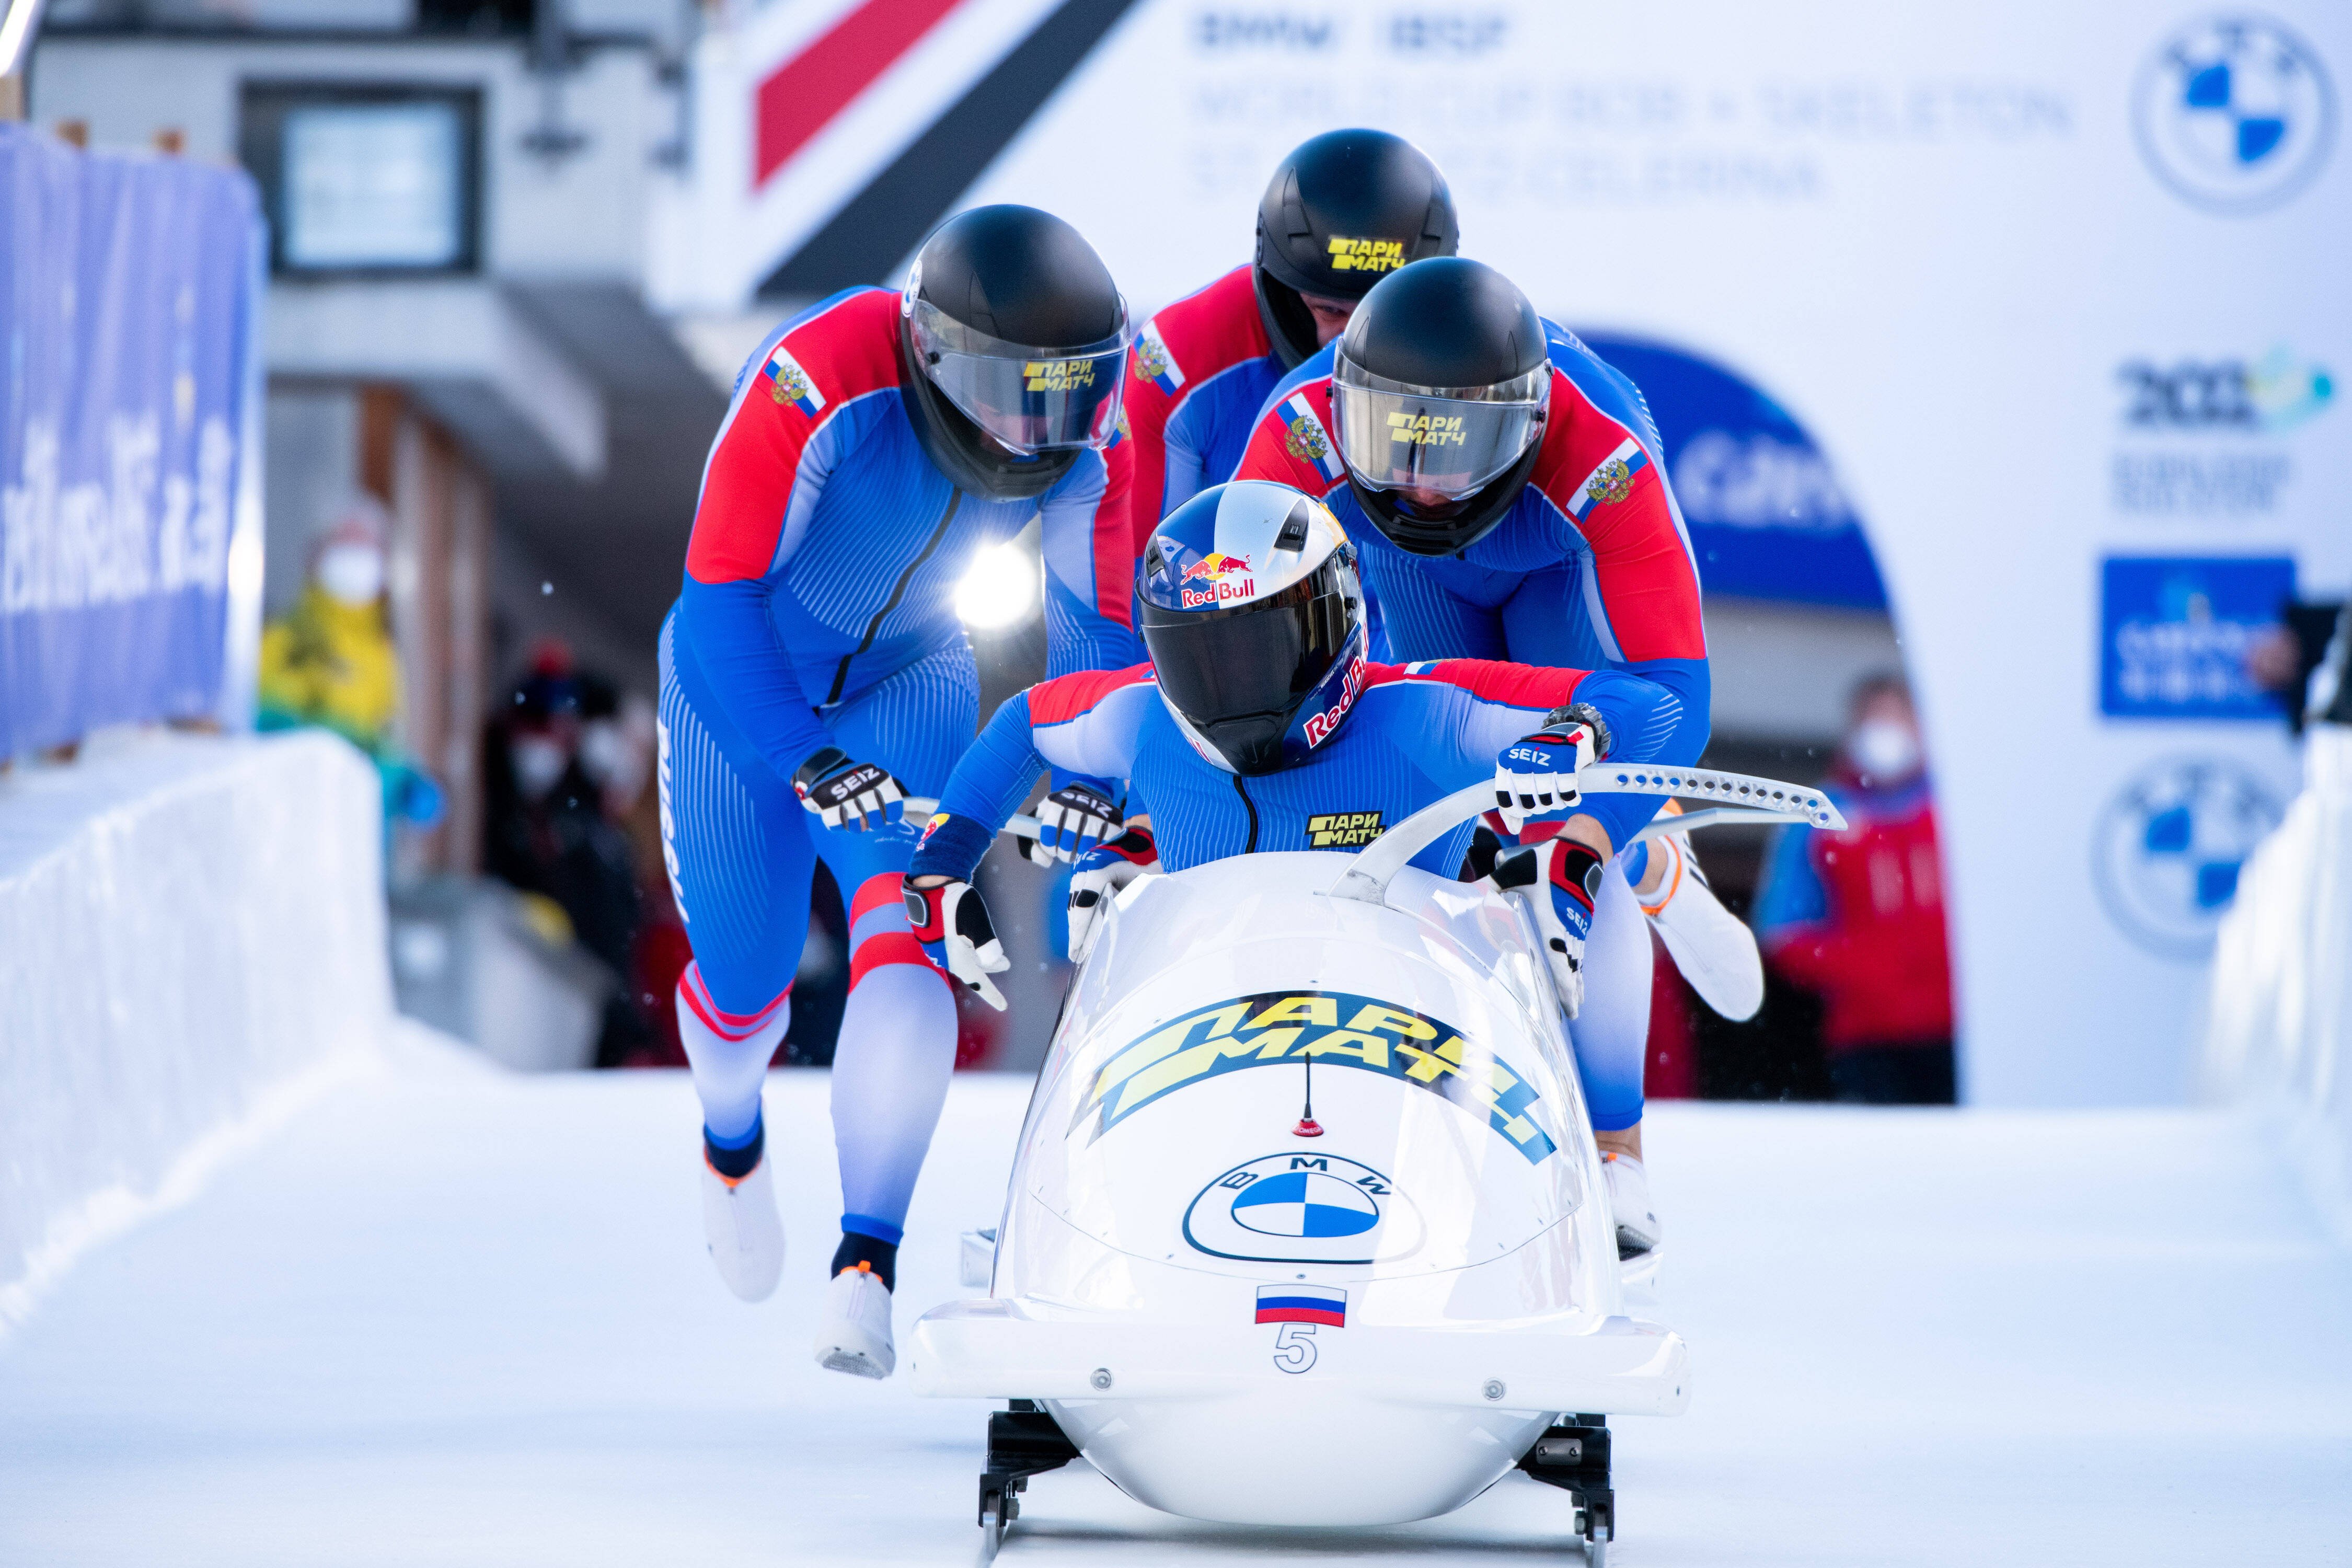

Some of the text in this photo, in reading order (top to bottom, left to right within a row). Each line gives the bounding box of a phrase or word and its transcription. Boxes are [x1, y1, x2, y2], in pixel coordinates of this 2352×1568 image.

[1328, 238, 1403, 258] ПАРИ
[1331, 254, 1406, 272] МАТЧ
[1023, 359, 1093, 377] ПАРИ
[1027, 373, 1096, 391] МАТЧ
[1387, 412, 1462, 431] ПАРИ
[1391, 428, 1466, 446] МАТЧ
[1181, 579, 1255, 608] Red Bull
[1304, 673, 1353, 748] Red
[1309, 814, 1379, 832] ПАРИ
[1313, 828, 1383, 846] МАТЧ
[1087, 997, 1518, 1110] ПАРИ
[1109, 1027, 1539, 1145] МАТЧ
[1219, 1157, 1392, 1195] BMW
[1273, 1322, 1318, 1374] 5
